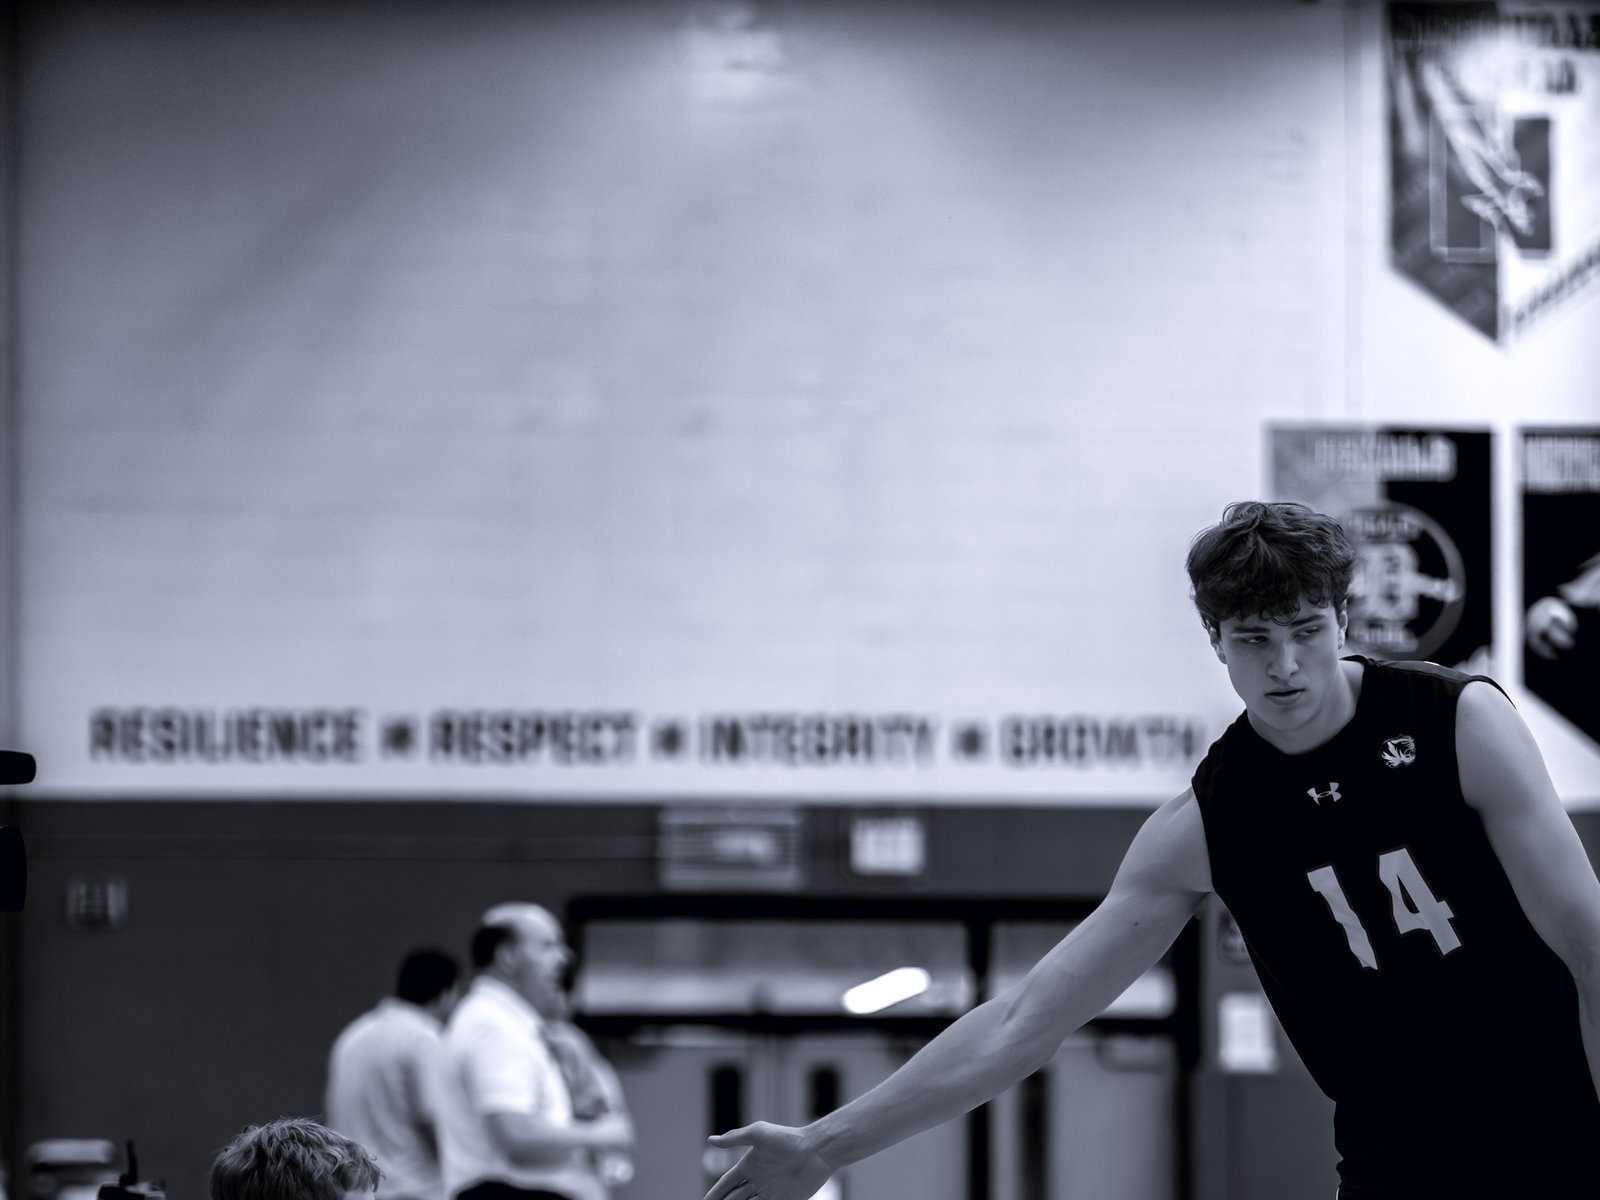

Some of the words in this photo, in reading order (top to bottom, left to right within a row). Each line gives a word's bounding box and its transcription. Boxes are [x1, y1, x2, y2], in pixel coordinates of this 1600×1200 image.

[89, 708, 368, 764] RESILIENCE
[430, 710, 638, 766] RESPECT
[698, 712, 934, 768] INTEGRITY
[1000, 713, 1206, 769] GROWTH
[1306, 847, 1463, 971] 14
